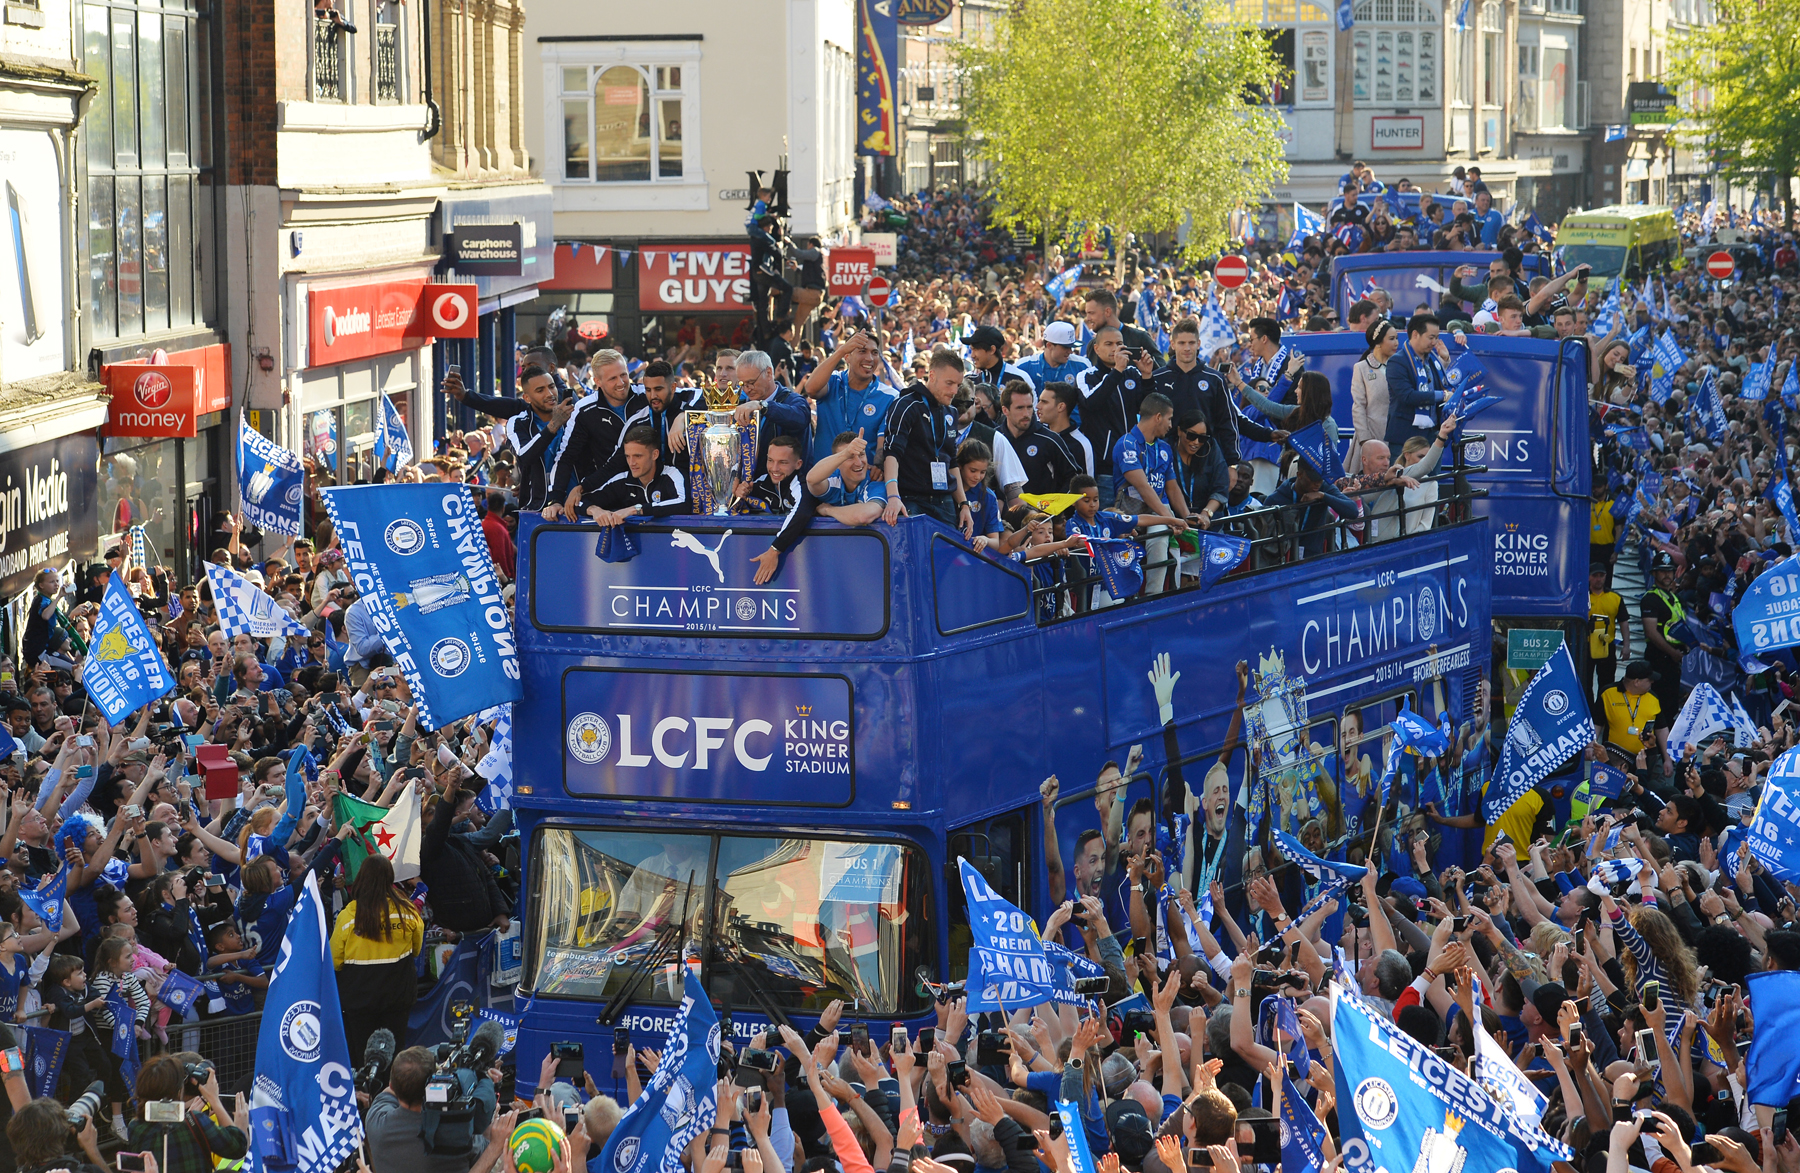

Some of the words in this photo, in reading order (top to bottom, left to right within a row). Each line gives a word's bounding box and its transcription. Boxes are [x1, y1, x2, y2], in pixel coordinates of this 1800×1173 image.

[1640, 114, 1652, 122] TO
[1375, 128, 1420, 138] HUNTER
[462, 238, 513, 249] Carphone
[1567, 231, 1616, 240] AMBULANCE
[458, 249, 517, 259] Warehouse
[668, 251, 743, 275] FIVE
[835, 262, 869, 274] FIVE
[659, 278, 751, 304] GUYS
[335, 307, 370, 336] vodafone
[374, 310, 395, 330] Leicester
[137, 380, 169, 403] Virgin
[119, 412, 186, 431] money
[242, 432, 303, 469] EICEST
[743, 443, 752, 481] BARCLAYS
[25, 457, 68, 525] Media
[29, 541, 47, 569] PHONE
[48, 531, 68, 562] MOBILE
[1495, 533, 1549, 551] KING
[1494, 551, 1548, 564] POWER
[1377, 570, 1395, 588] LCFC
[1494, 565, 1548, 576] STADIUM
[691, 585, 711, 593] LCFC
[1108, 576, 1118, 596] LEAGUE
[102, 582, 164, 690] LEICESTER
[685, 622, 717, 631] 2015/16
[1523, 639, 1541, 648] BUS
[1543, 639, 1550, 648] 2
[120, 659, 140, 681] 16
[1375, 660, 1403, 684] 2015/16
[1412, 650, 1471, 684] #FOREVERFEARLESS
[106, 663, 130, 693] LEAGUE
[571, 713, 598, 736] LEICESTER
[784, 719, 849, 741] KING
[615, 713, 774, 772] LCFC
[785, 742, 849, 759] POWER
[785, 759, 850, 775] STADIUM
[1754, 815, 1779, 842] 16
[844, 858, 868, 870] BUS
[872, 858, 878, 870] 1
[829, 875, 891, 887] CHAMPIONS
[993, 910, 1024, 933] 20
[990, 935, 1032, 951] PREM
[546, 950, 613, 962] teambus.co.uk
[51, 1037, 65, 1070] FOREVER
[1408, 1069, 1426, 1090] WE
[1427, 1084, 1452, 1105] ARE
[1451, 1100, 1507, 1140] FEARLESS
[1292, 1125, 1320, 1170] FEARLESS
